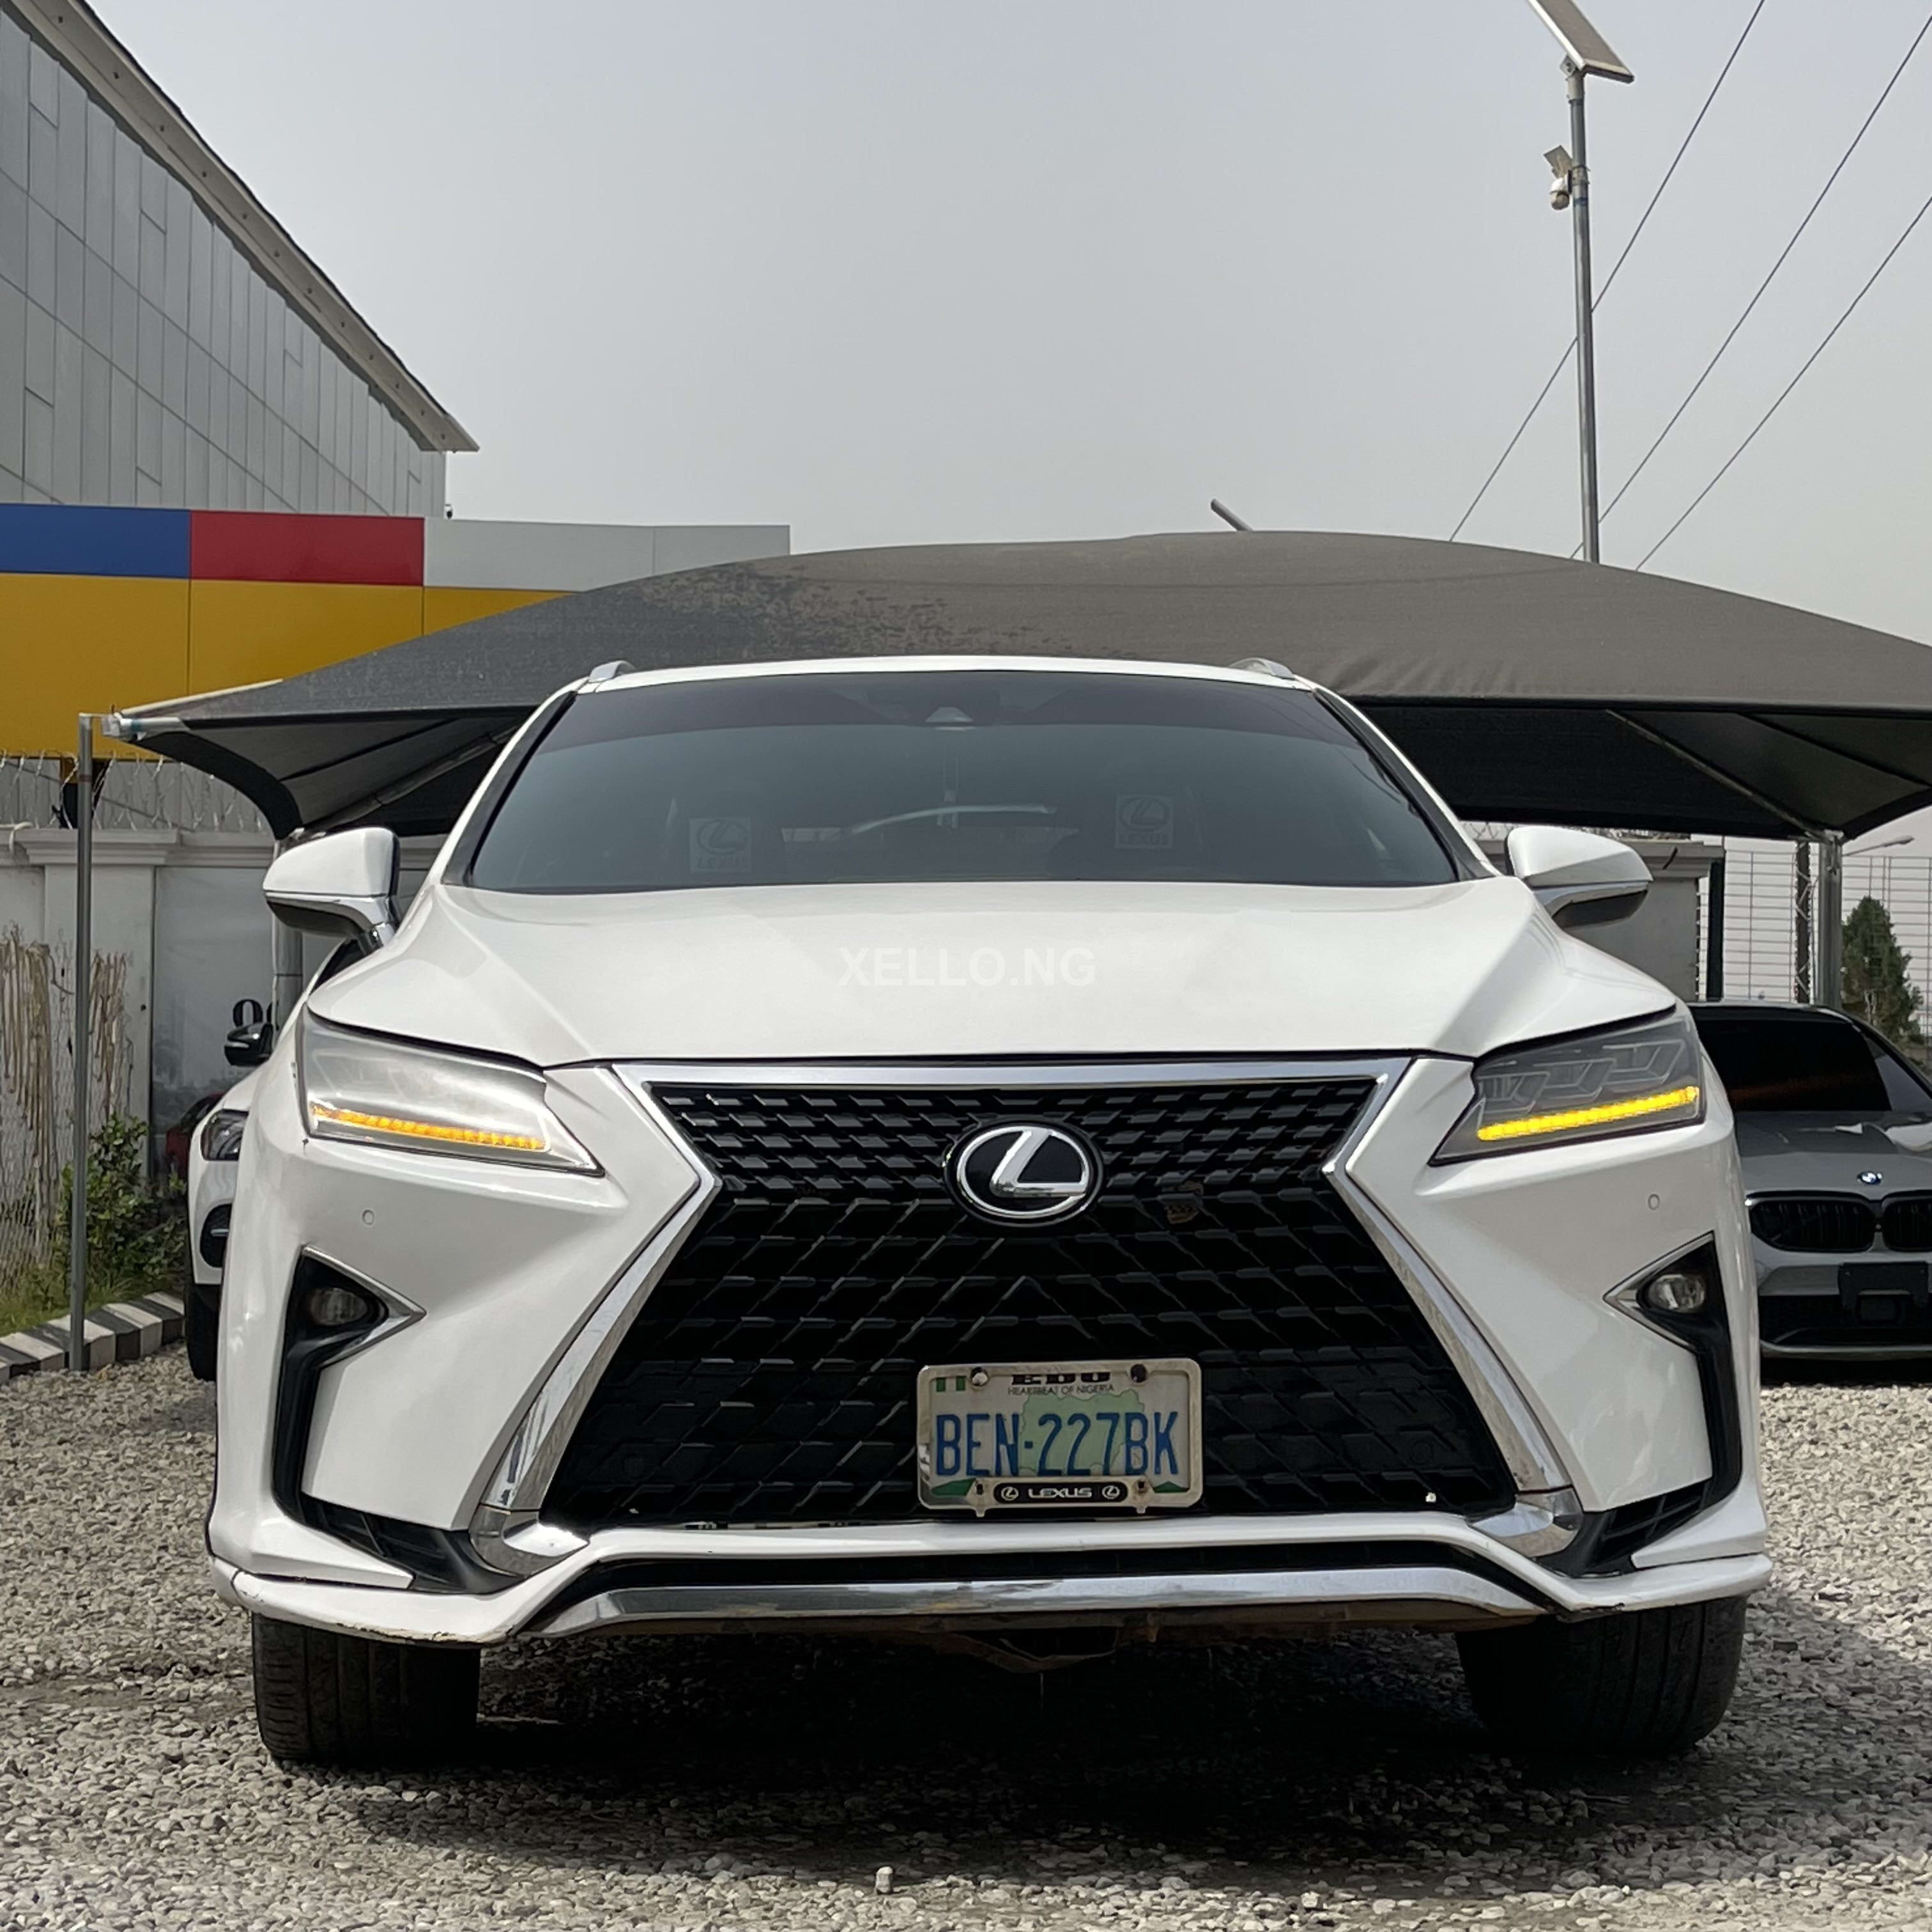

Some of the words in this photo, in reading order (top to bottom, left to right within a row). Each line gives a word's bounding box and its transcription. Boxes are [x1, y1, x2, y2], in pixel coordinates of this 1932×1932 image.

[1061, 1385, 1072, 1395] OF
[1077, 1384, 1114, 1393] NIGERIA
[936, 1411, 1178, 1476] BEN-227BK
[1028, 1487, 1092, 1498] LEXUS
